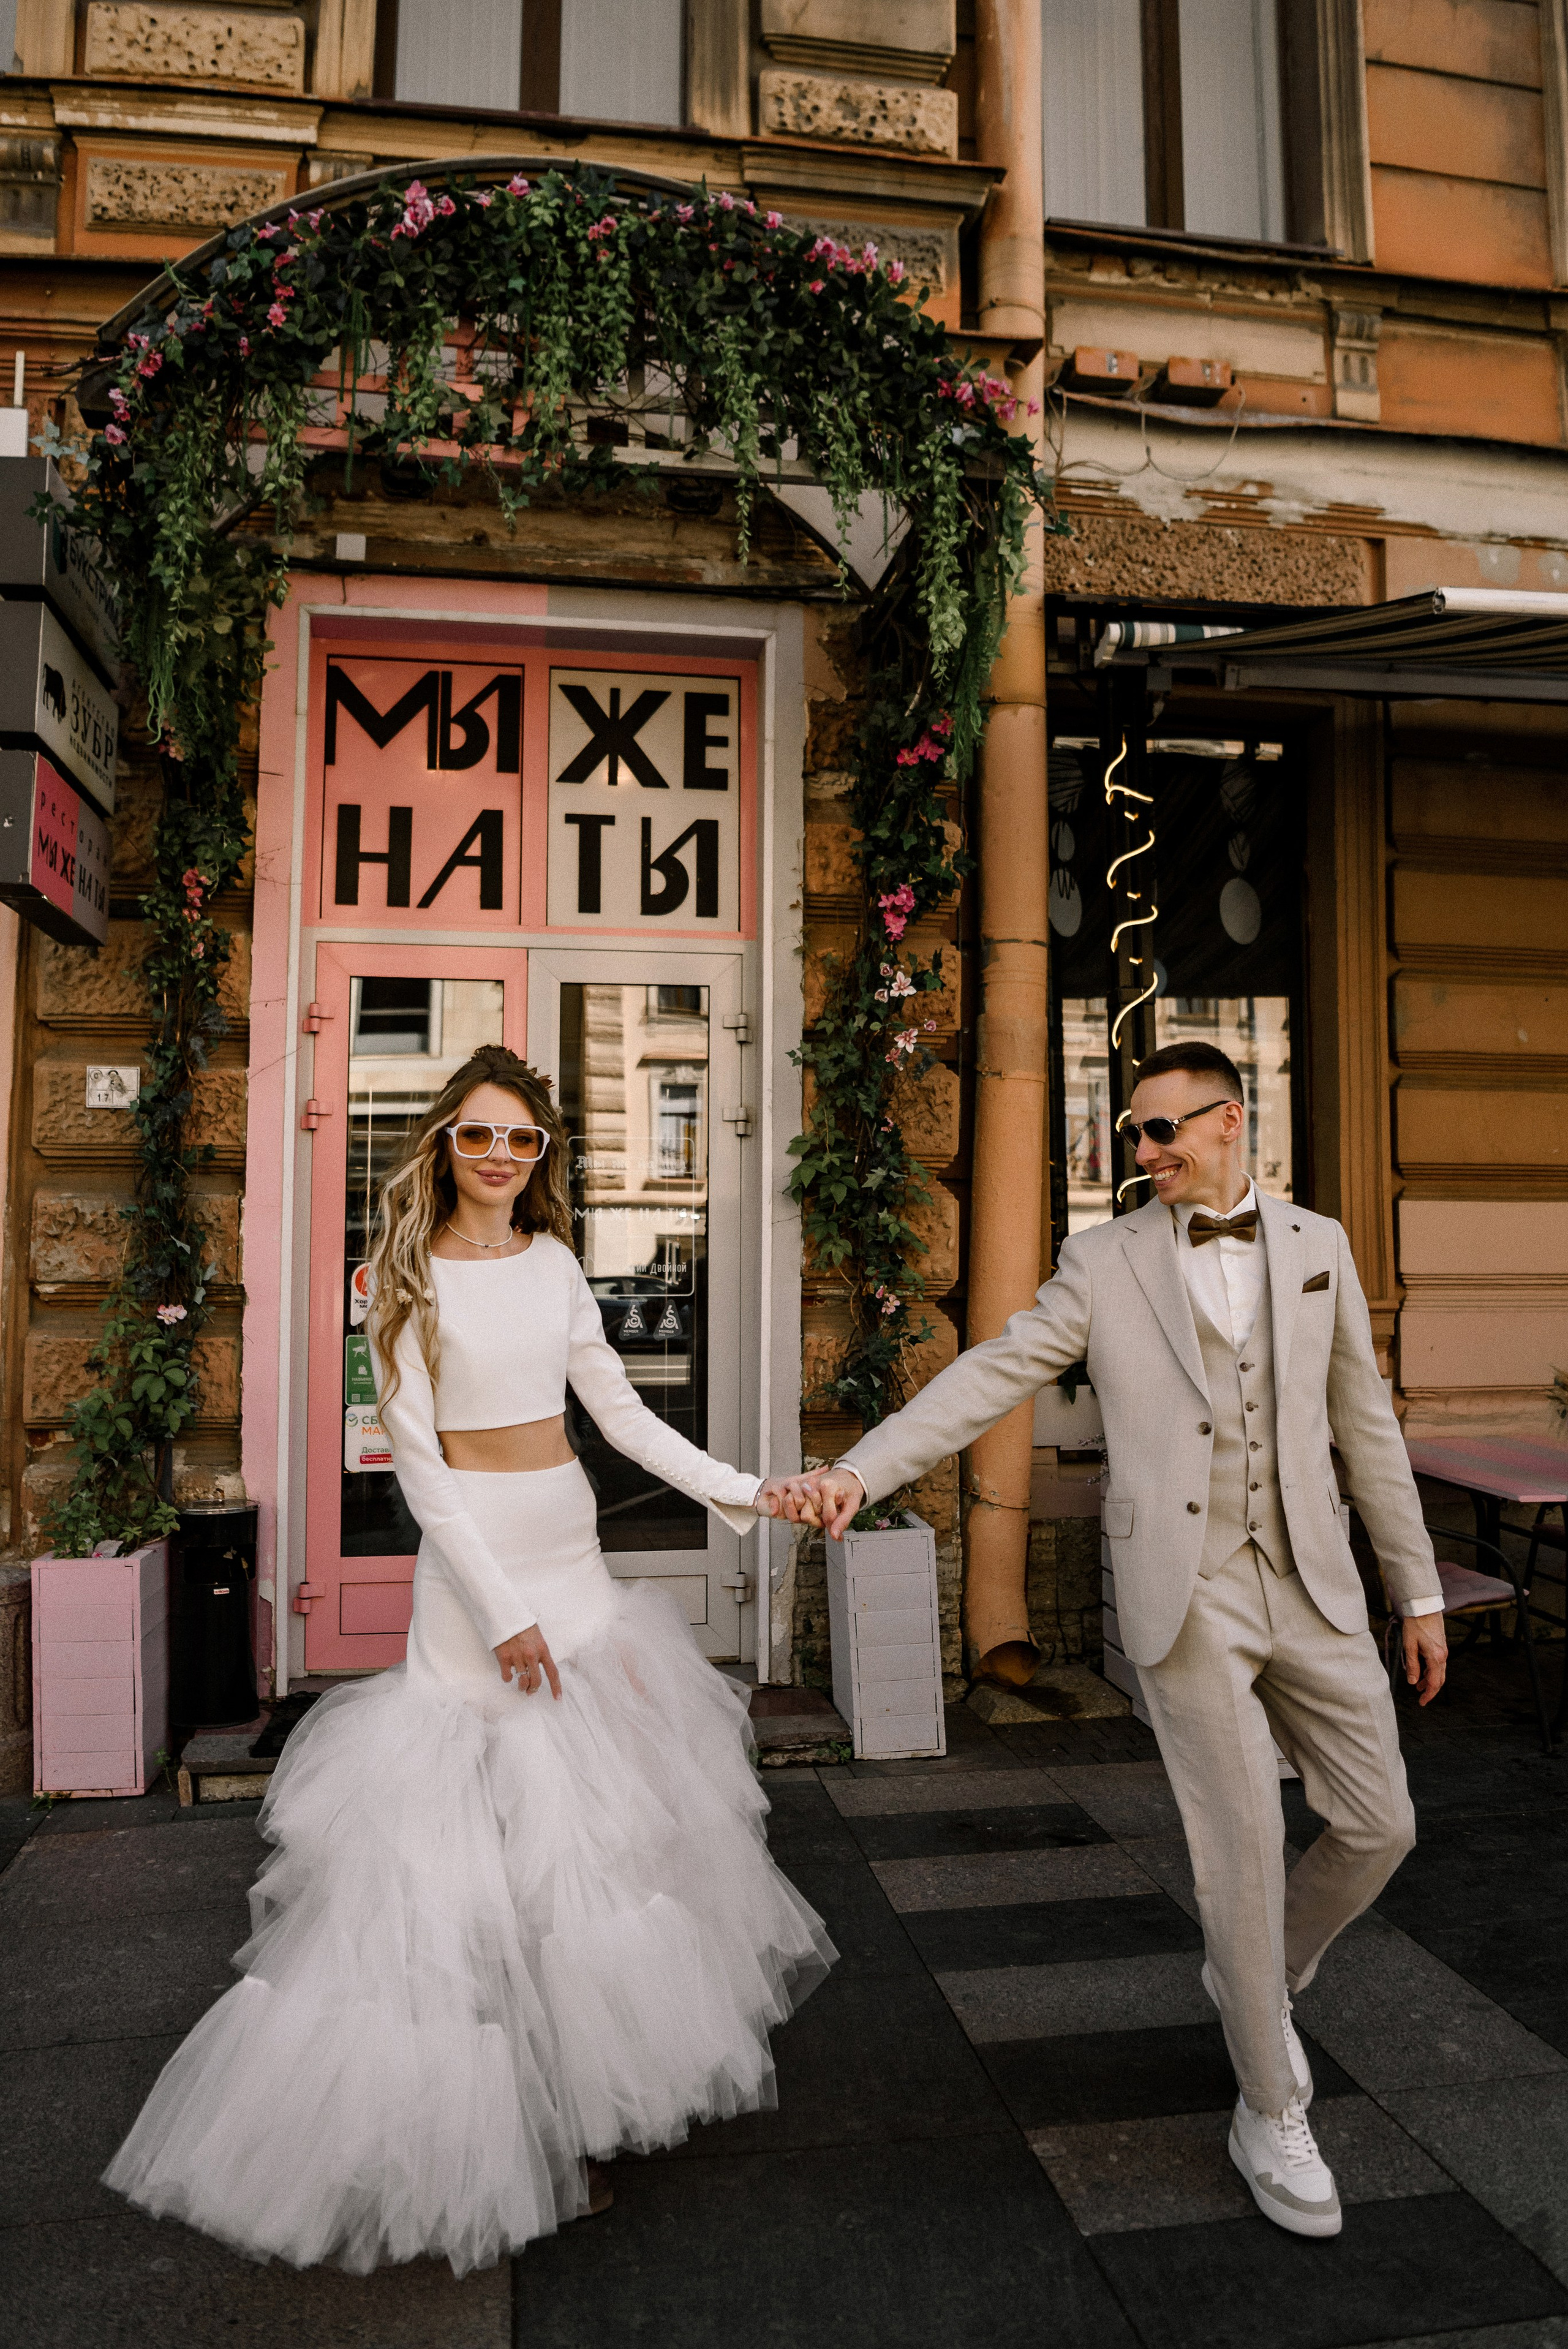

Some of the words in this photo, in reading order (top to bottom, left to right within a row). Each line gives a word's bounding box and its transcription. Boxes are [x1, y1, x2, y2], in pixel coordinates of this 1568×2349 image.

[70, 693, 114, 769] ЗУБР
[325, 665, 521, 773] МЫ
[556, 684, 729, 791] ЖЕ
[38, 826, 57, 872] МЫ
[60, 846, 76, 888] ЖЕ
[78, 864, 92, 903] НА
[40, 791, 108, 869] ресторан
[334, 804, 503, 910] НА
[564, 813, 719, 918] ТЫ
[650, 1262, 687, 1275] Двойной
